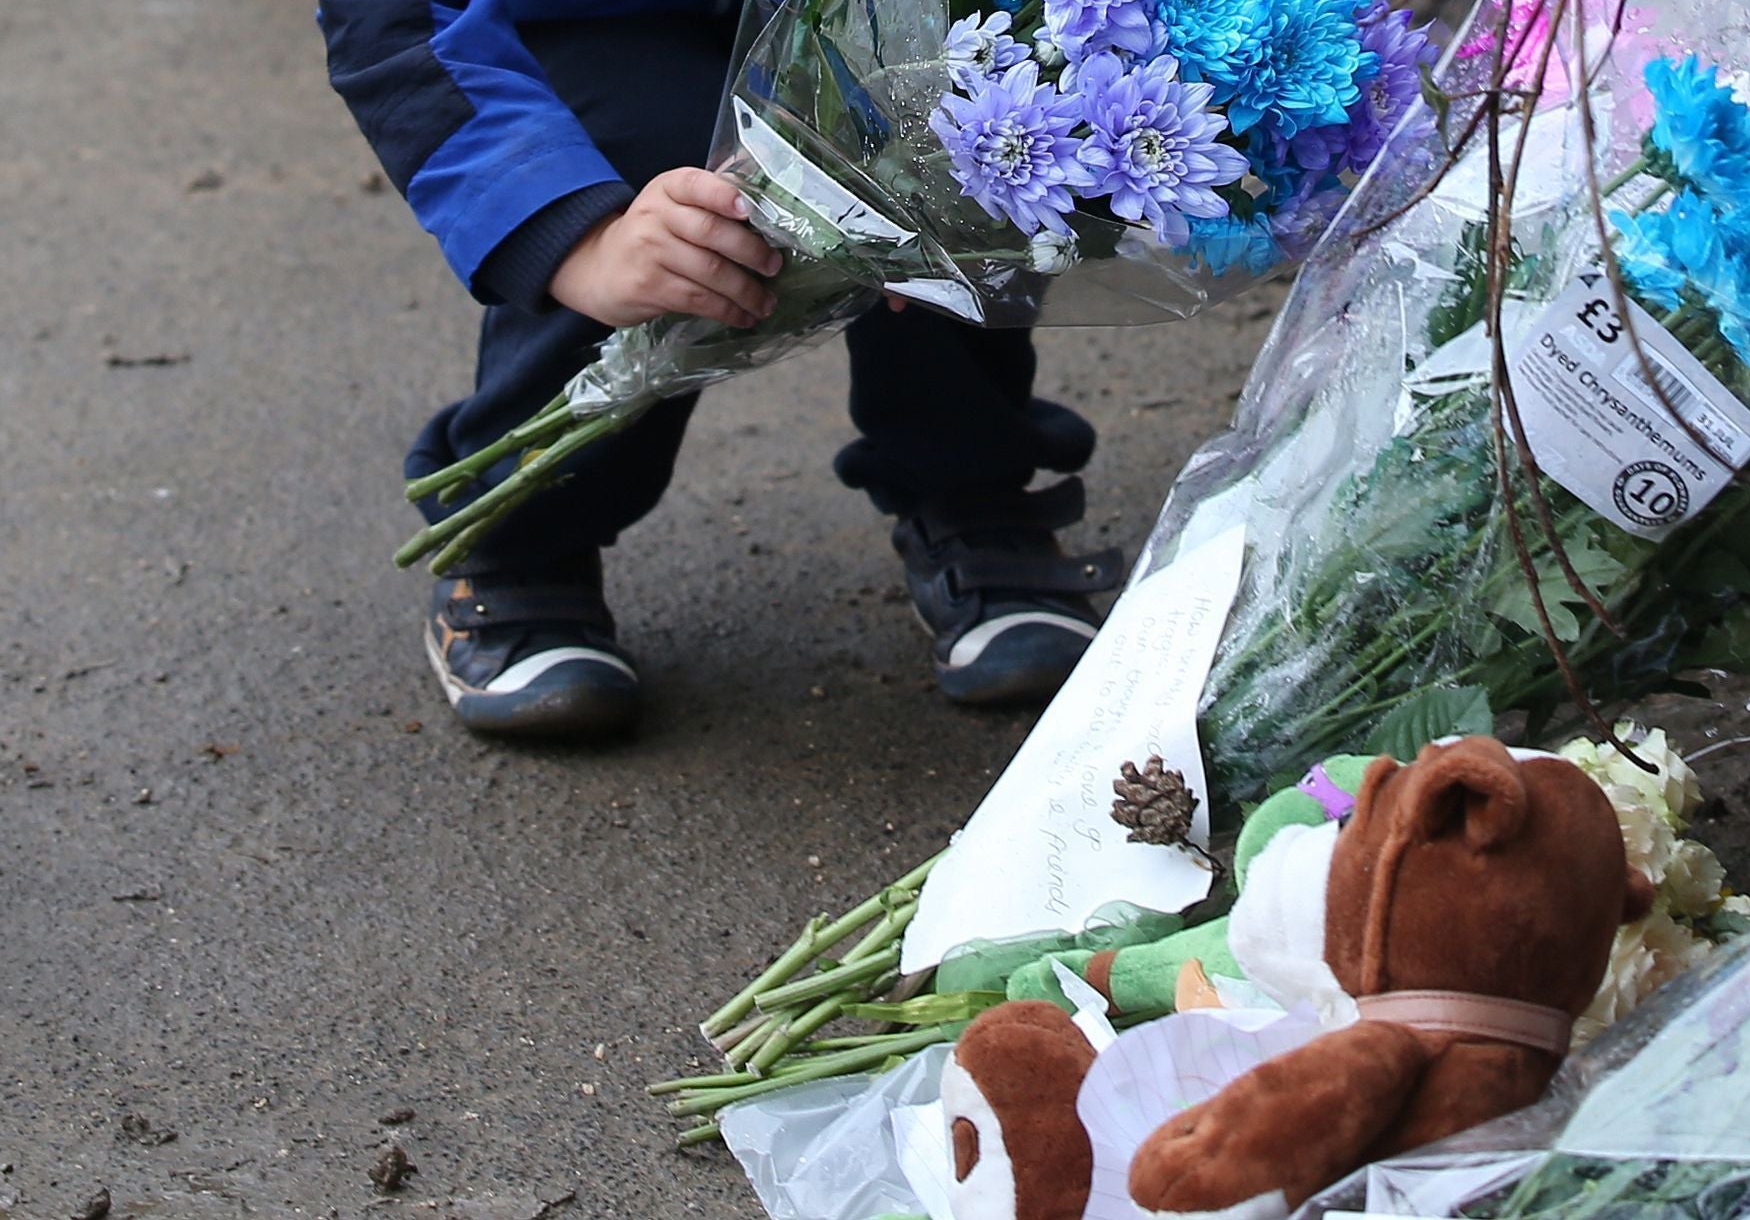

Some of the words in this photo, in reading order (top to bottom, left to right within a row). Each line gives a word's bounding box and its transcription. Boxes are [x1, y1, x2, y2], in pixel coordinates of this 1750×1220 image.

[1576, 299, 1623, 343] £3
[1540, 333, 1581, 373] Dyed
[1579, 371, 1706, 481] Chrysanthemums
[1697, 412, 1714, 430] 31
[1628, 478, 1675, 515] 10
[1186, 596, 1212, 638] How
[1080, 764, 1099, 807] love
[1072, 817, 1101, 852] go
[1038, 827, 1072, 916] friends
